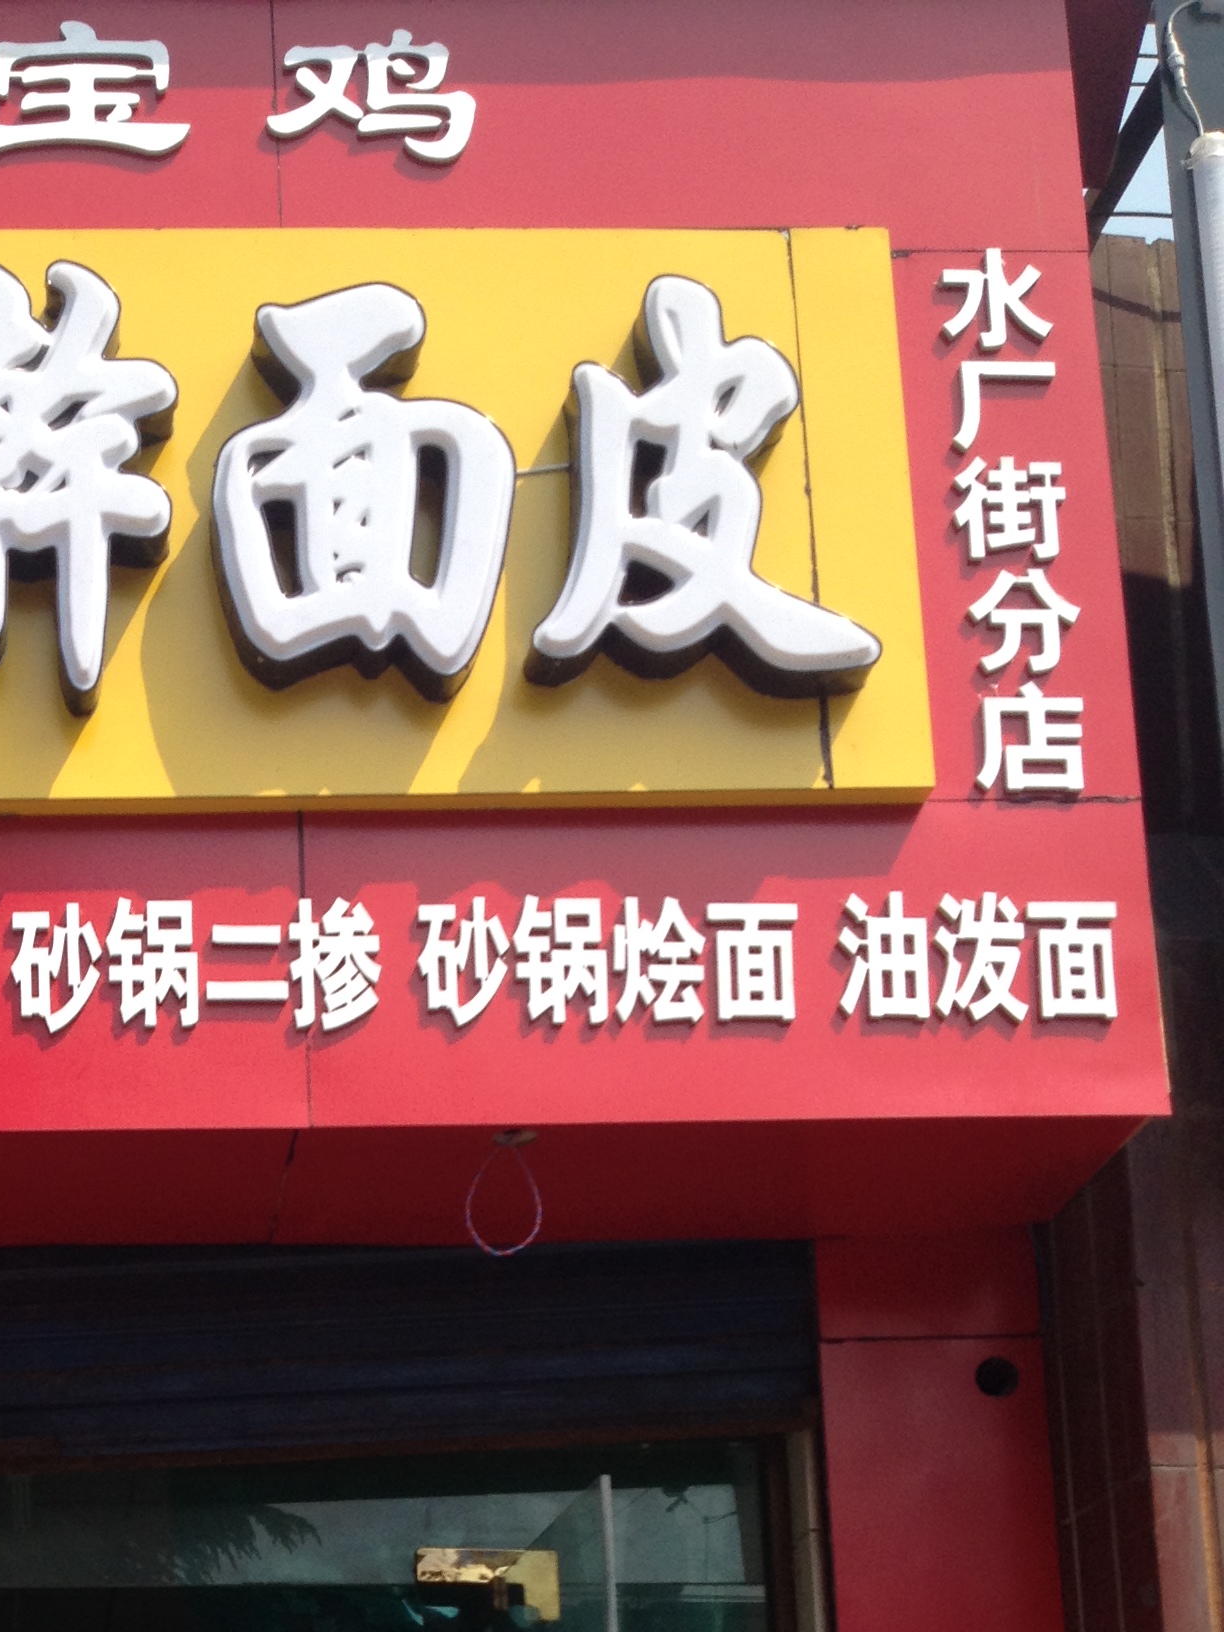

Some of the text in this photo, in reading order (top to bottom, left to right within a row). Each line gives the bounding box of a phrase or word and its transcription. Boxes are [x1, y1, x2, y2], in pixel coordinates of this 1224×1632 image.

[941, 247, 1086, 794] 水厂街分店
[10, 896, 382, 1034] 砂锅二掺
[417, 893, 799, 1027] 砂锅烩面
[838, 890, 1119, 1023] 油泼面
